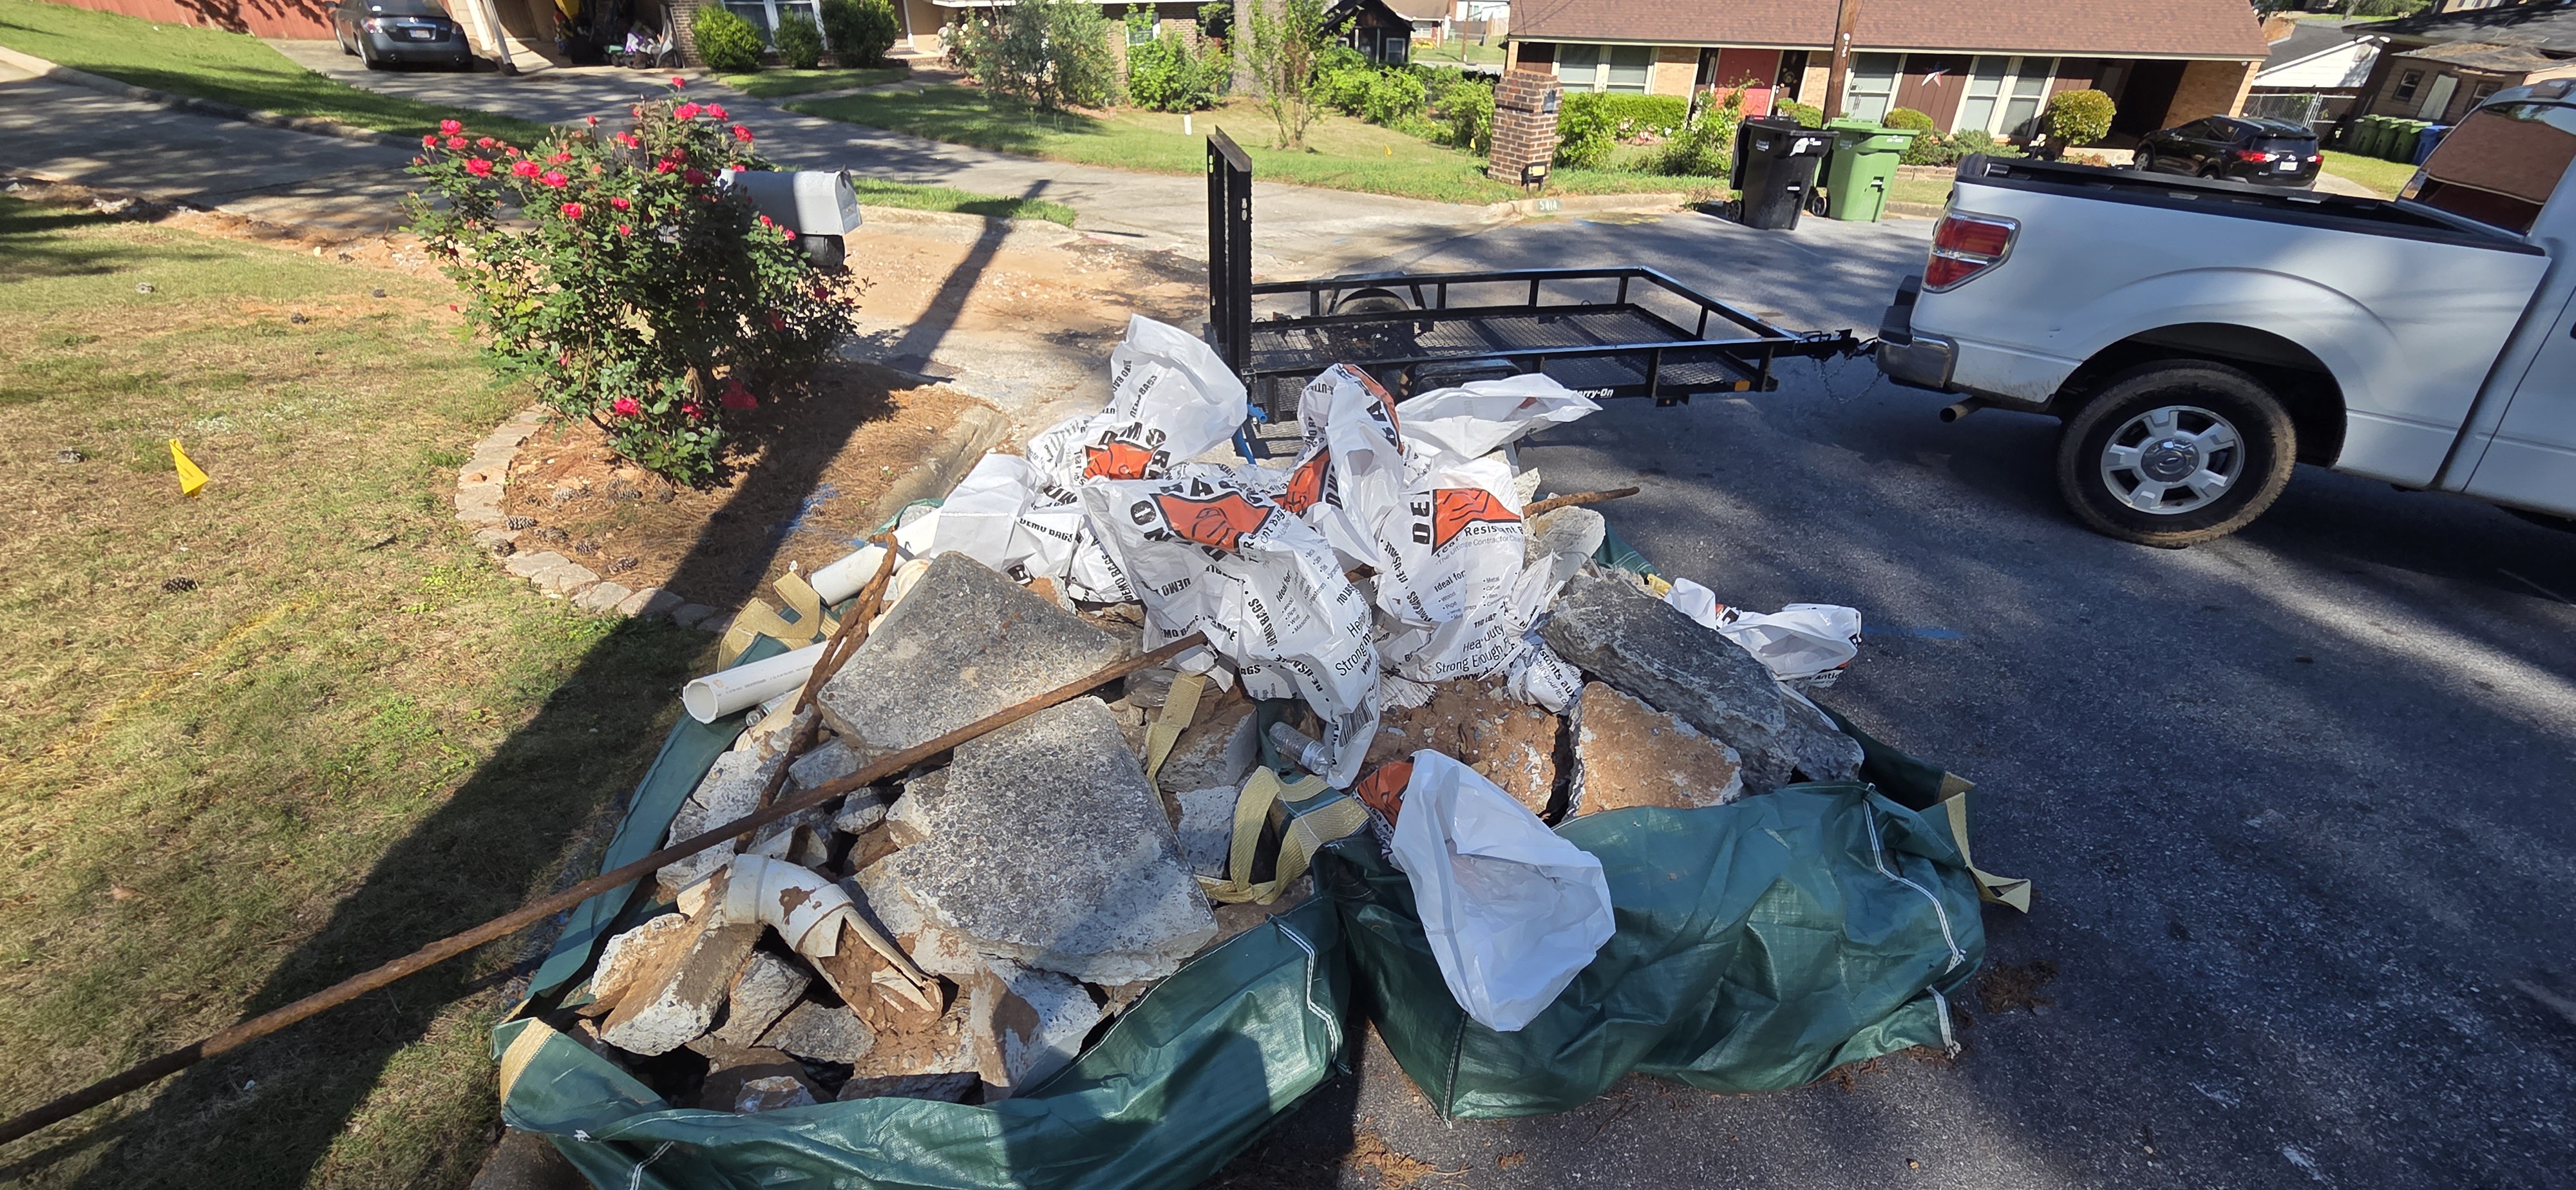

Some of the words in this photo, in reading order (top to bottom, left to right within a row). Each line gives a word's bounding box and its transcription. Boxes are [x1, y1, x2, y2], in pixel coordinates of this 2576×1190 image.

[1574, 388, 1614, 399] arry-On
[1434, 536, 1459, 558] Tear
[1464, 524, 1515, 537] Resisant
[1115, 578, 1134, 601] DEMO
[1161, 578, 1191, 596] DEMO
[1276, 581, 1288, 602] Ideal
[1434, 574, 1454, 592] Ideal
[1337, 593, 1347, 606] 110
[1344, 583, 1354, 598] LBS
[1441, 592, 1455, 602] Wood
[1247, 598, 1271, 627] BAGS
[1446, 600, 1457, 609] Pipe
[1474, 620, 1484, 628] 110
[1264, 623, 1278, 648] DEMO
[1336, 643, 1367, 677] Strong
[1435, 658, 1468, 674] Strong
[1561, 681, 1577, 699] aux
